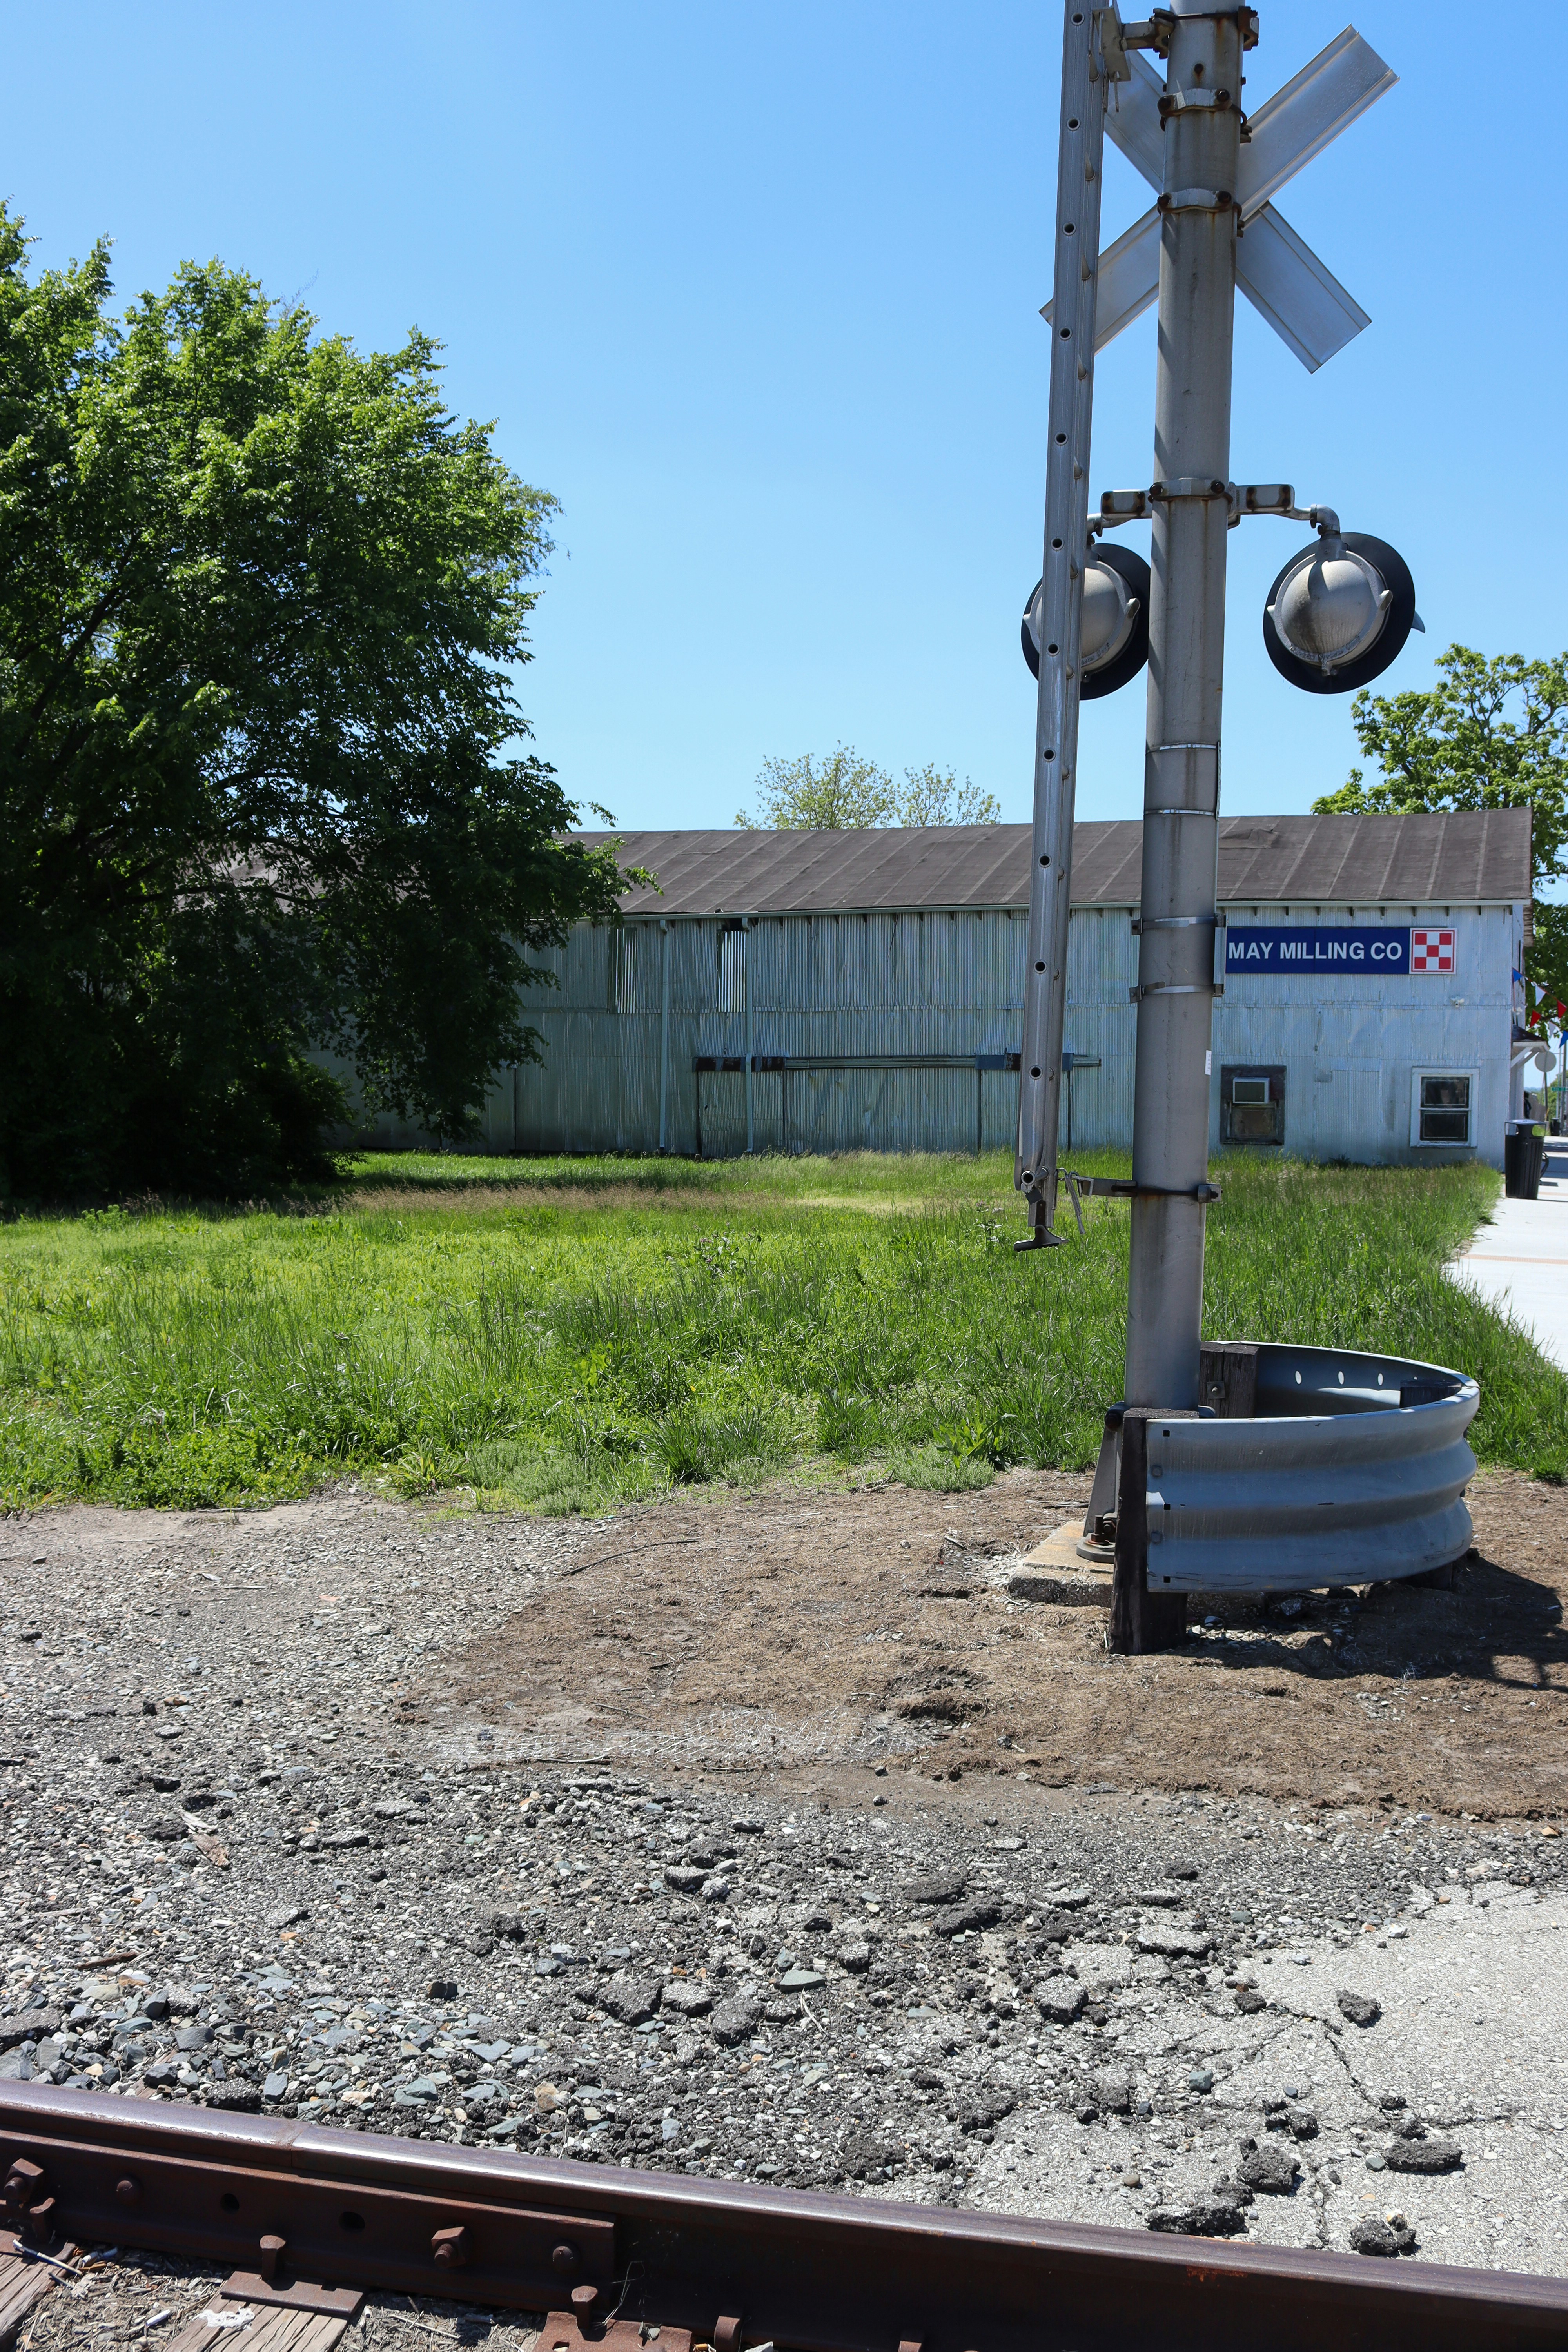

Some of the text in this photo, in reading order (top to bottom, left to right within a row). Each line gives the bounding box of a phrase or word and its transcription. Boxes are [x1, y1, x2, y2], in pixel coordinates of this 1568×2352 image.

[1229, 942, 1402, 960] MAY MILLING CO
